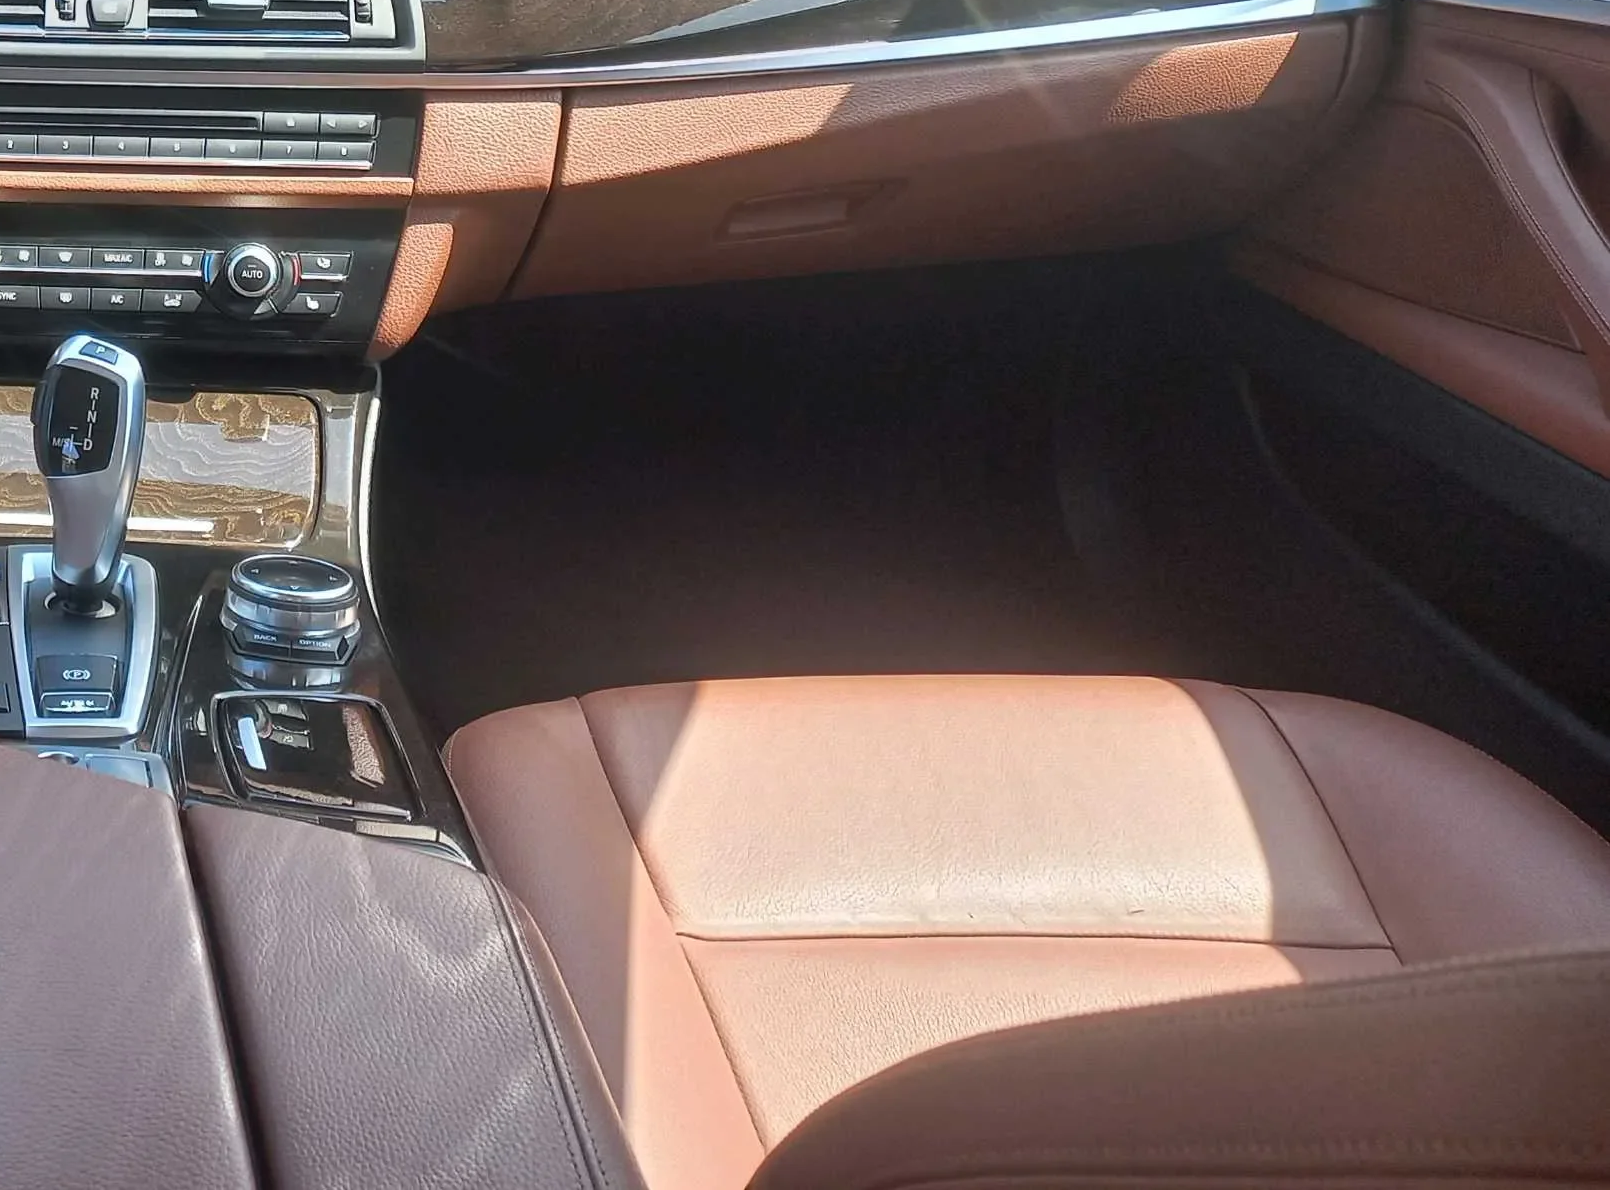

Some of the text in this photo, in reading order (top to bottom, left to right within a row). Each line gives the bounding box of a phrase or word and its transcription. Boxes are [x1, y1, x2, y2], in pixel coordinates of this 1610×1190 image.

[241, 270, 263, 279] AUTO
[90, 387, 99, 400] R
[86, 410, 97, 423] N
[83, 438, 93, 451] D
[253, 634, 277, 642] BACK
[299, 639, 332, 648] OPTION
